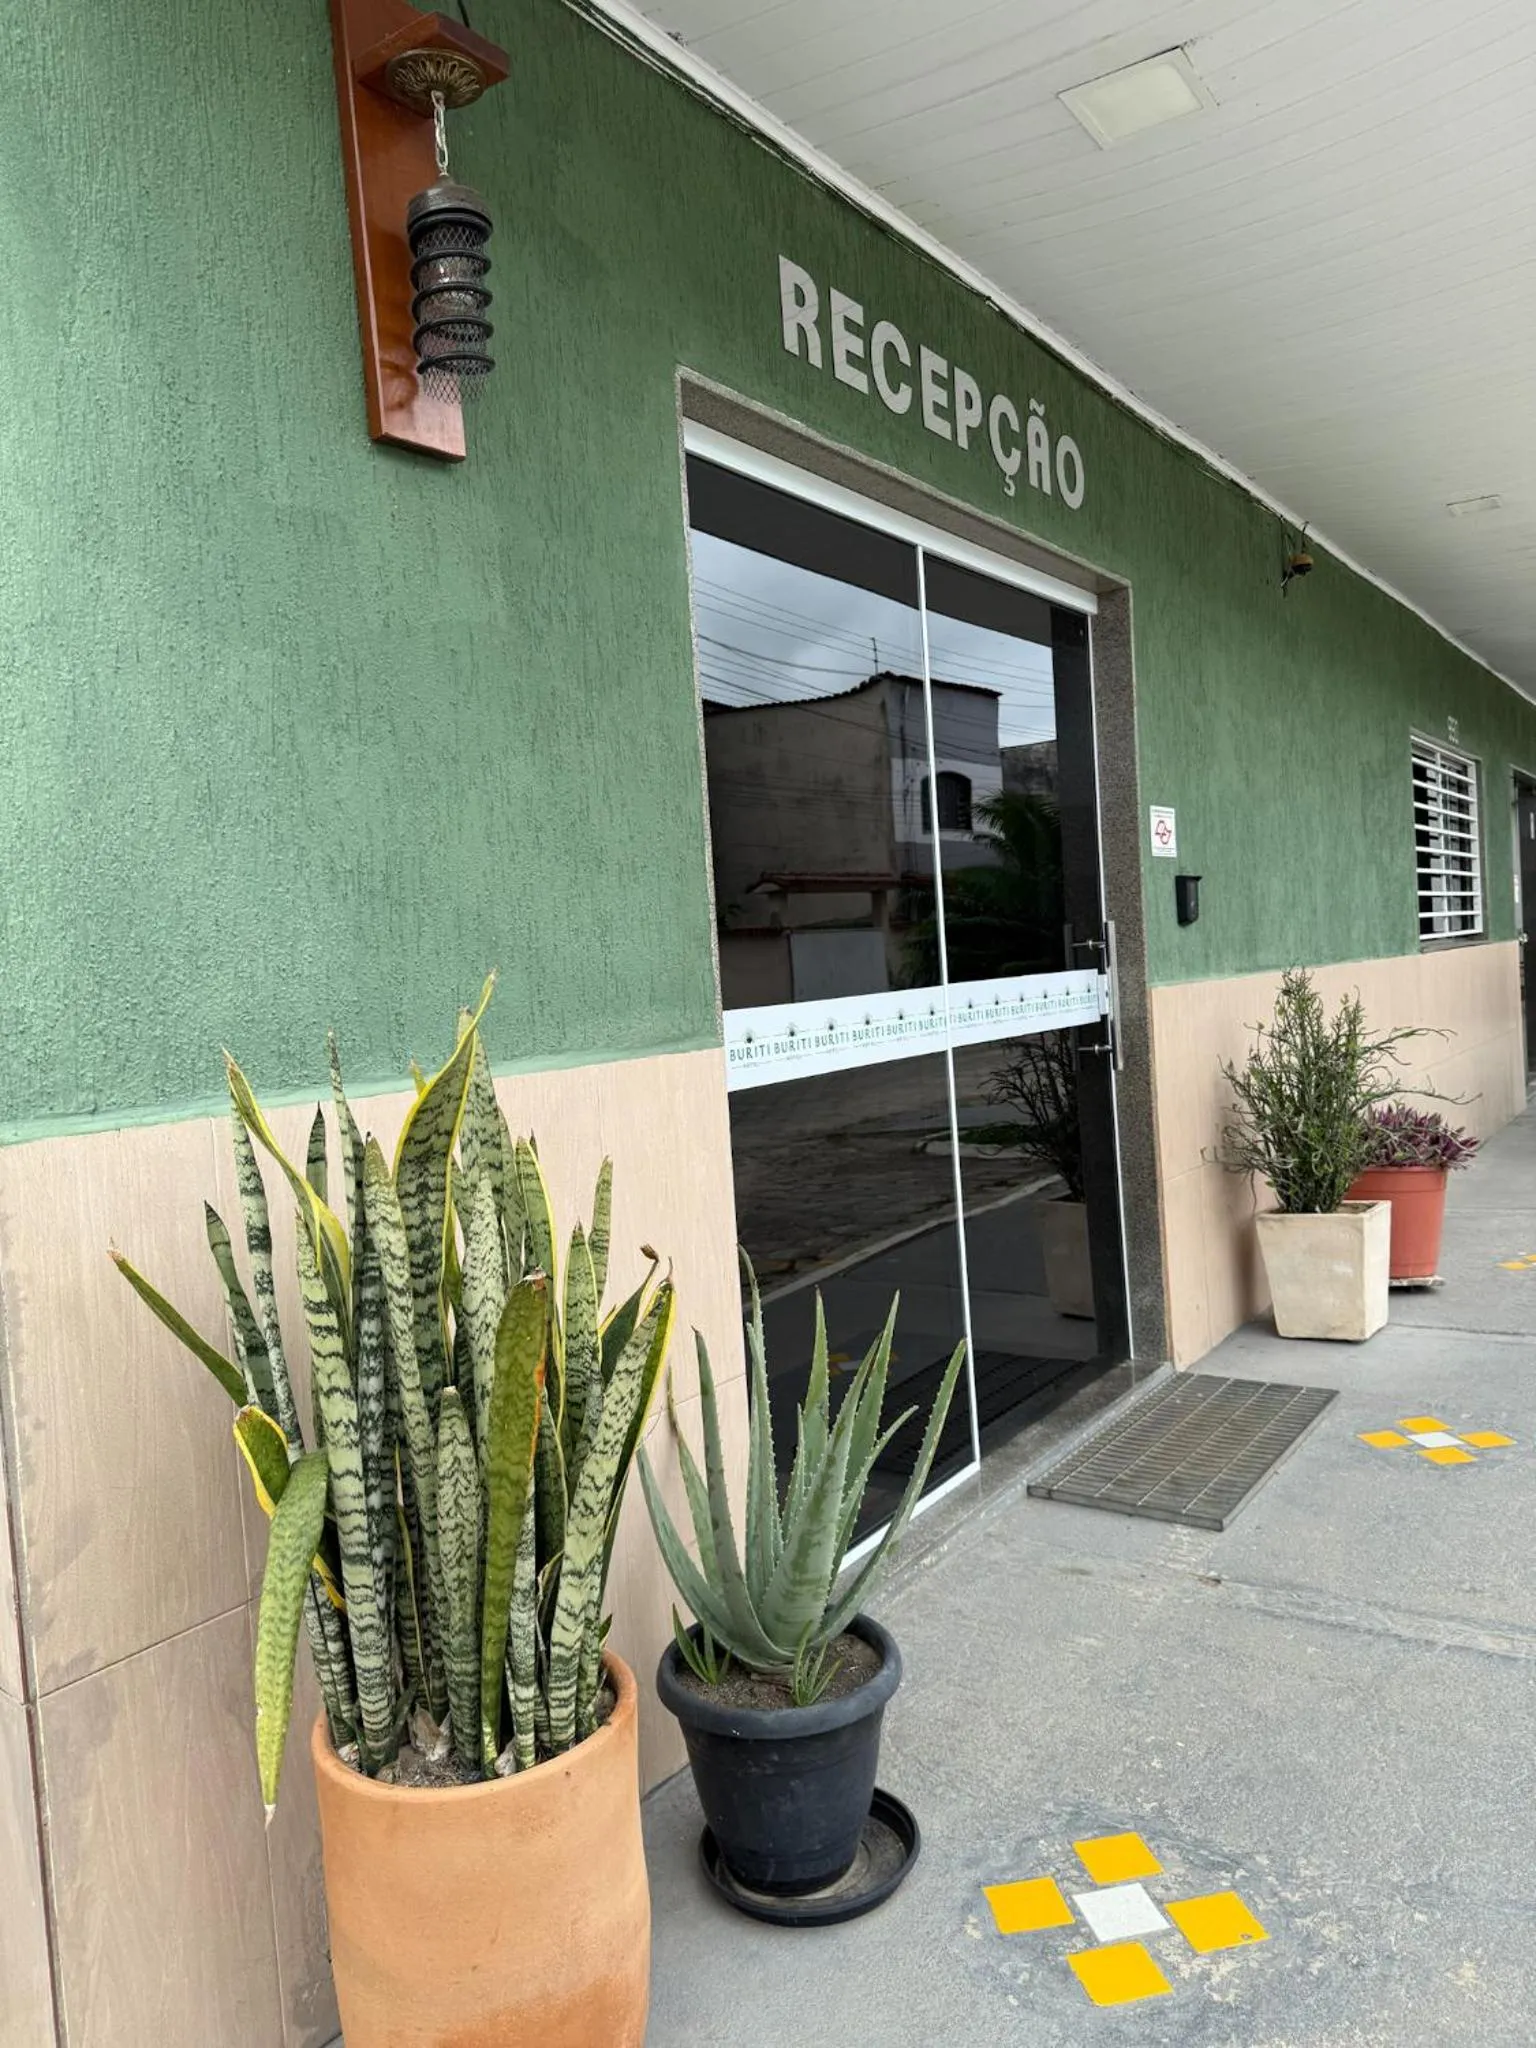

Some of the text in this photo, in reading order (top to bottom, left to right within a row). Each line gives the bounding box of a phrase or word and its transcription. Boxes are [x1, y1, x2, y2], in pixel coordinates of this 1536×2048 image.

[779, 254, 1085, 509] RECEPÇÃO
[729, 1044, 771, 1062] BURITI
[774, 1038, 812, 1054] BURITI
[815, 1031, 849, 1047] BURITI
[852, 1026, 885, 1041] BURITI
[886, 1020, 917, 1036] BURITI
[919, 1015, 947, 1031] BURITI
